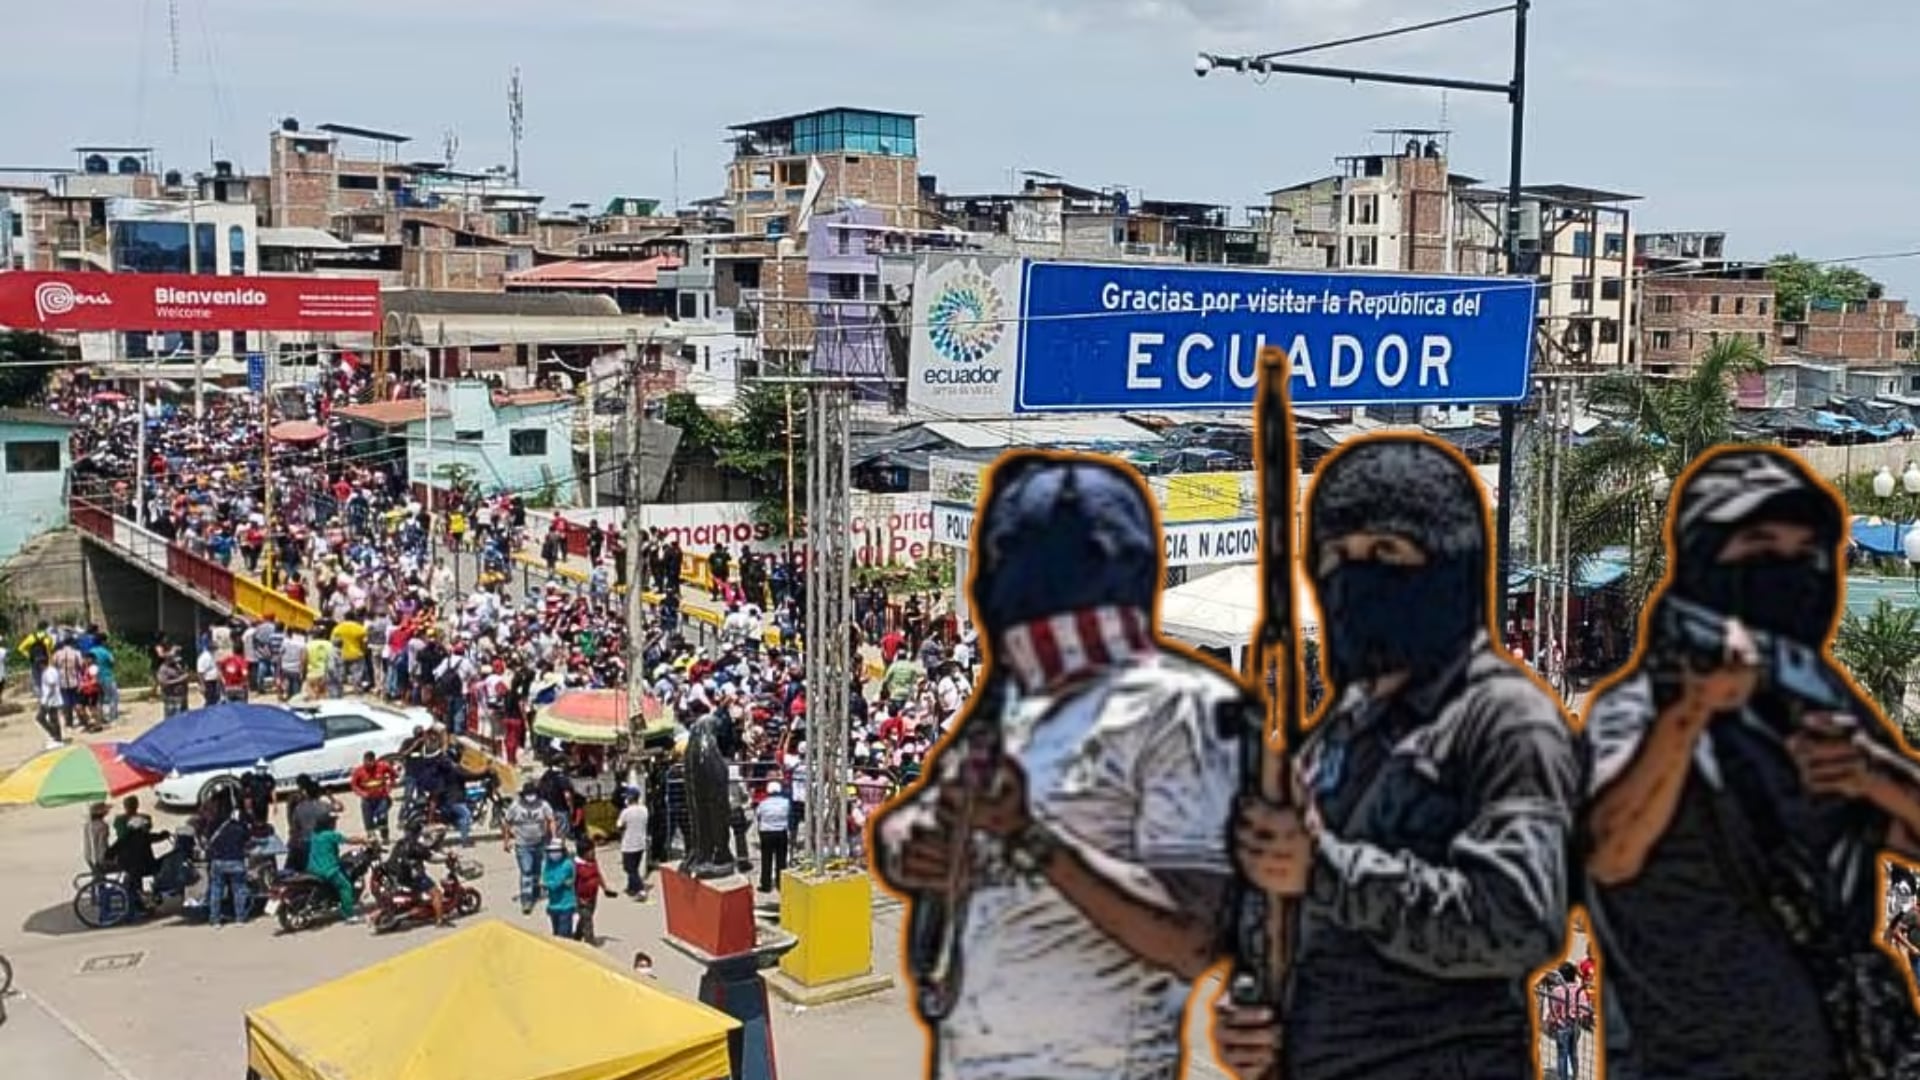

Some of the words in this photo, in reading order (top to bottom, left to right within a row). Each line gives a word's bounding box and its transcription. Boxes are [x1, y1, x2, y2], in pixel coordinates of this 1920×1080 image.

[154, 286, 268, 307] Bienvenido
[1101, 281, 1195, 312] Gracias
[1200, 290, 1241, 318] por
[1246, 285, 1318, 314] visitar
[1321, 287, 1342, 314] la
[1348, 289, 1447, 320] República
[1452, 289, 1482, 317] del
[155, 306, 214, 319] Welcome
[1126, 333, 1454, 390] ECUADOR
[924, 364, 1002, 384] ecuador
[946, 514, 973, 541] POLI
